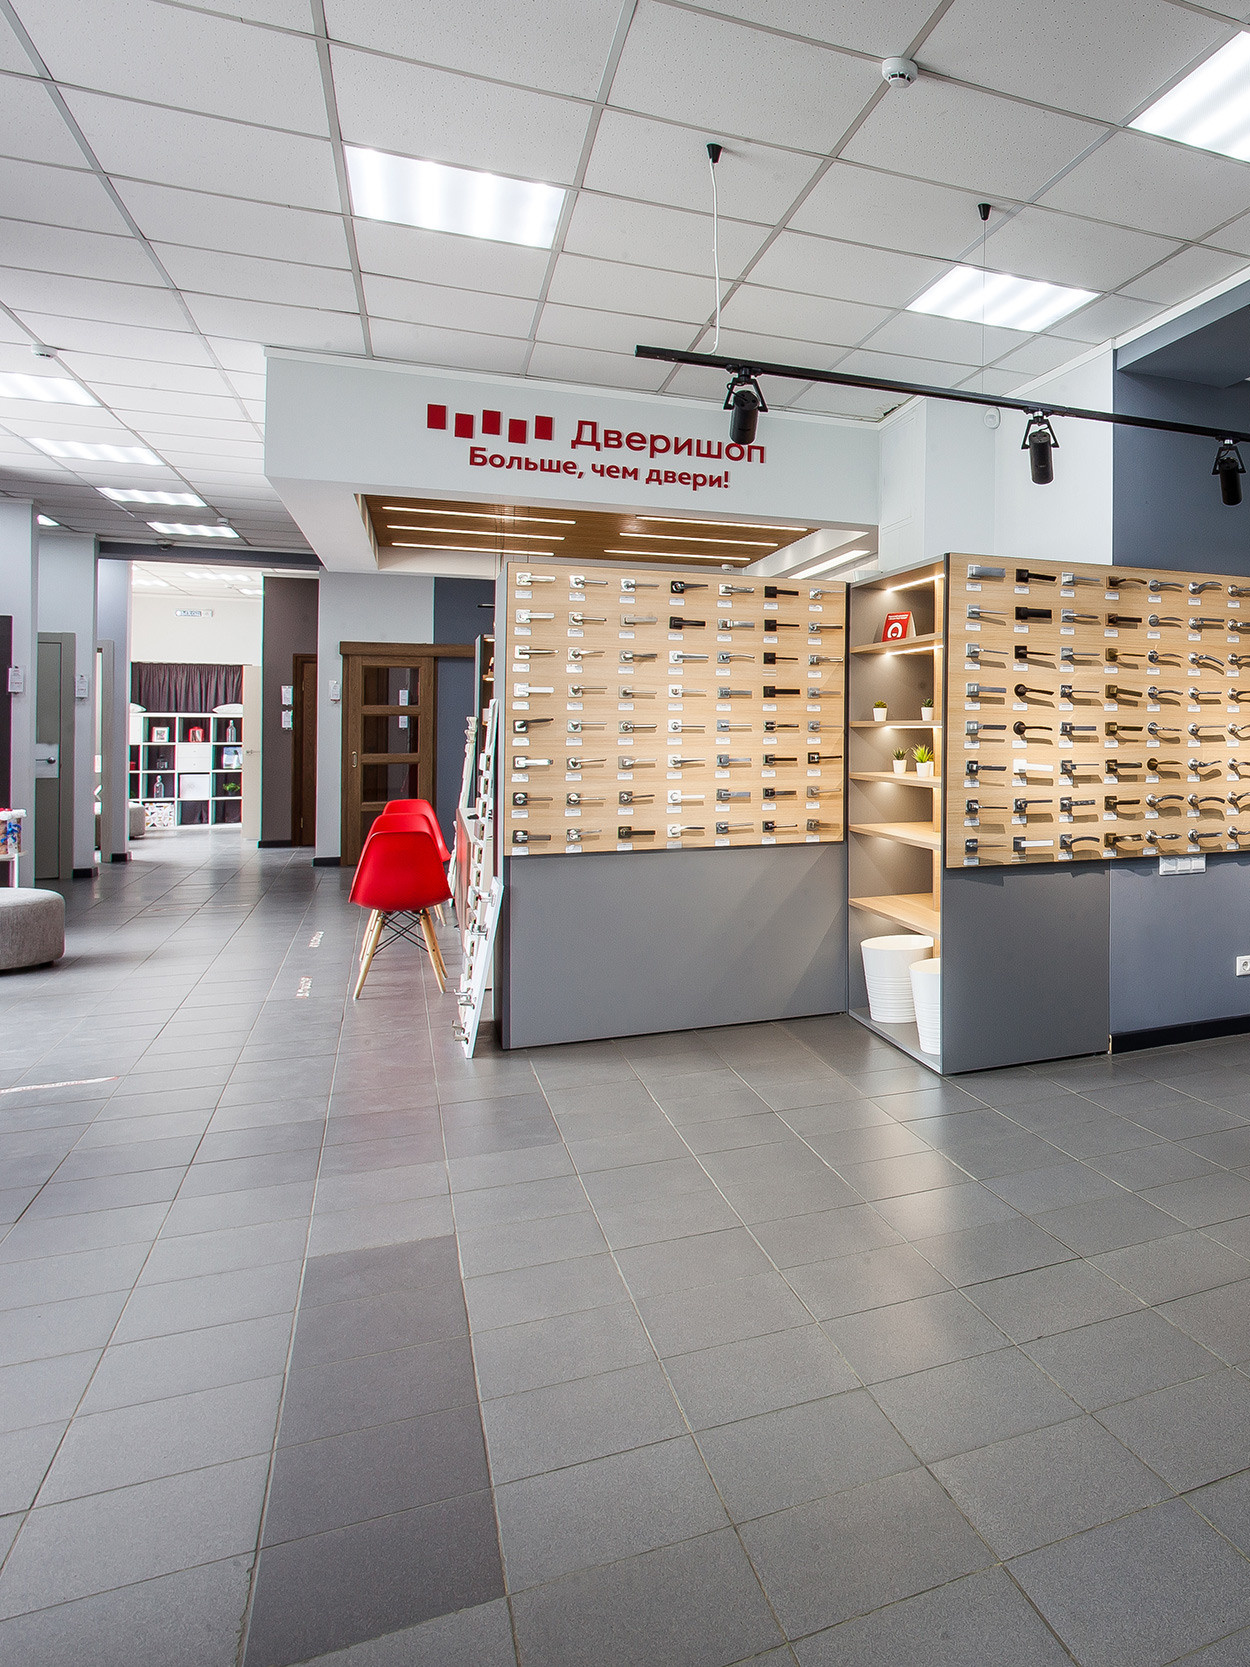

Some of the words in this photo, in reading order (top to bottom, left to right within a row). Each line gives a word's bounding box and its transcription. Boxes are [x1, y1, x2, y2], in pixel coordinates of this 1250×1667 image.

[570, 419, 766, 464] Дверишоп
[469, 445, 584, 479] Больше,
[591, 462, 639, 481] чем
[645, 467, 730, 491] двери!
